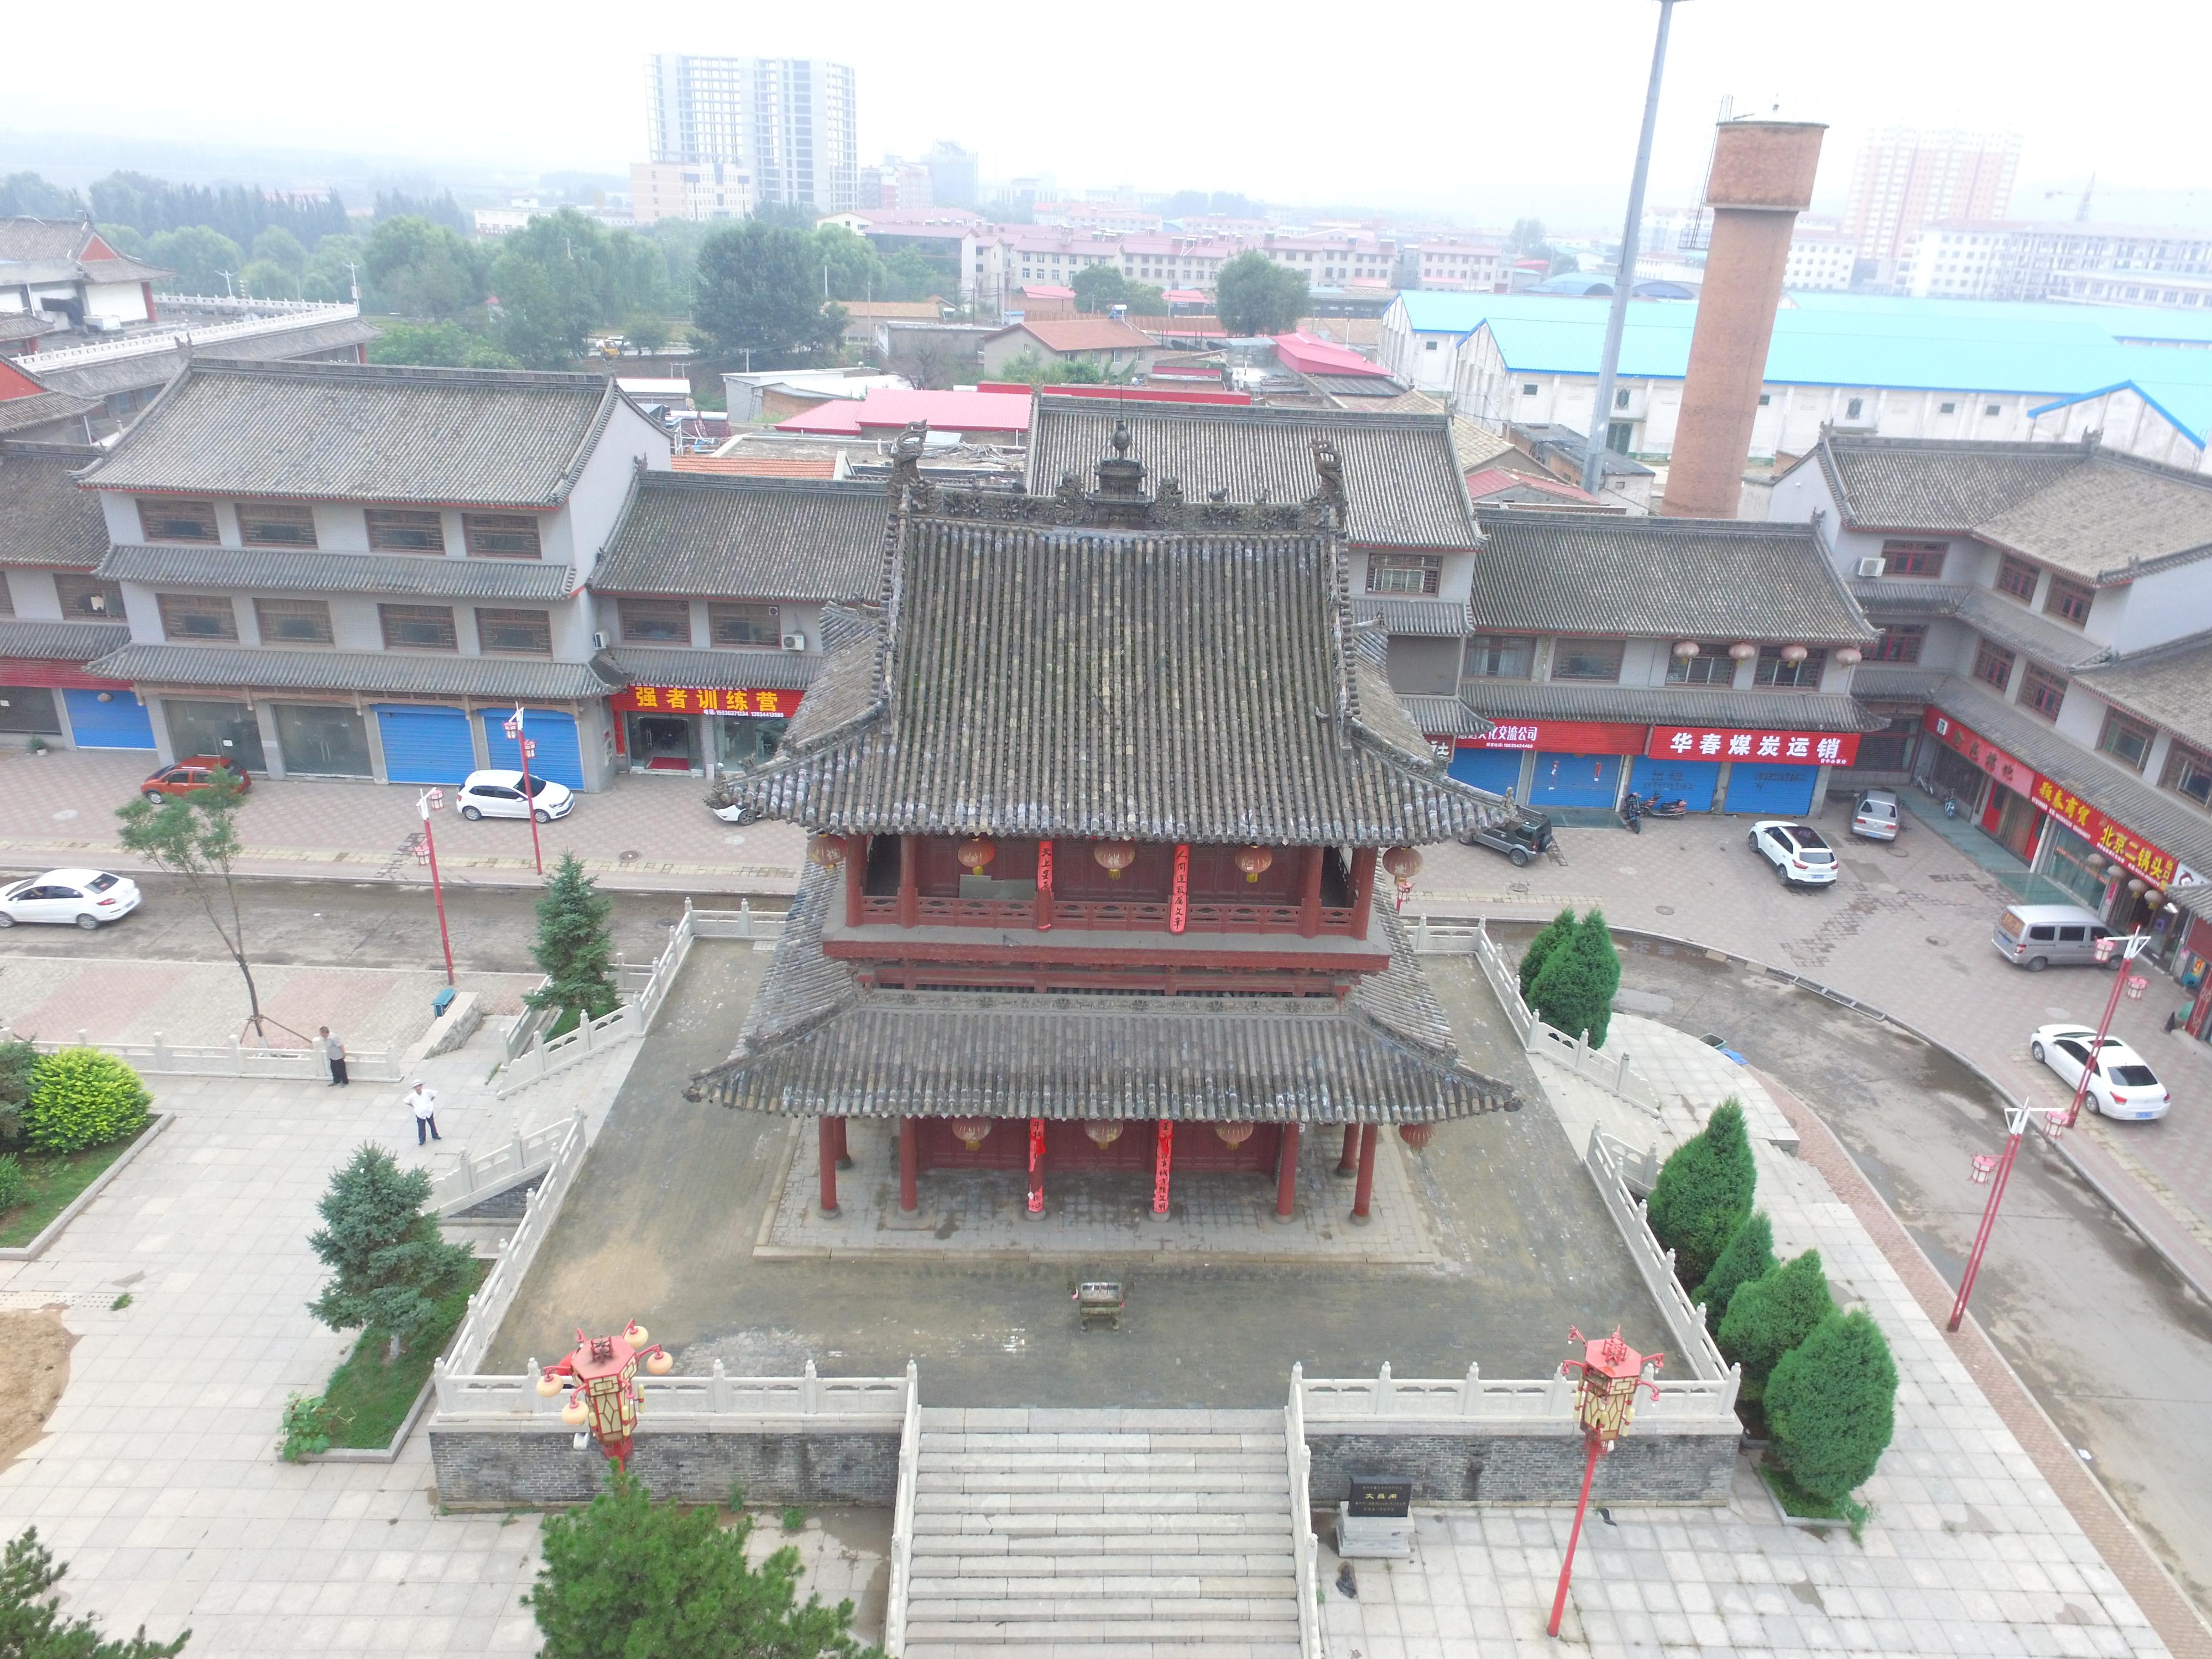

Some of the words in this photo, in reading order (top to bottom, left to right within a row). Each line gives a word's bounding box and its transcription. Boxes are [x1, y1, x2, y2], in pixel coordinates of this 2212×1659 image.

[635, 686, 778, 712] 强者训练营
[1670, 732, 1840, 759] 华春煤炭运销
[2101, 825, 2162, 879] 北京二锅头
